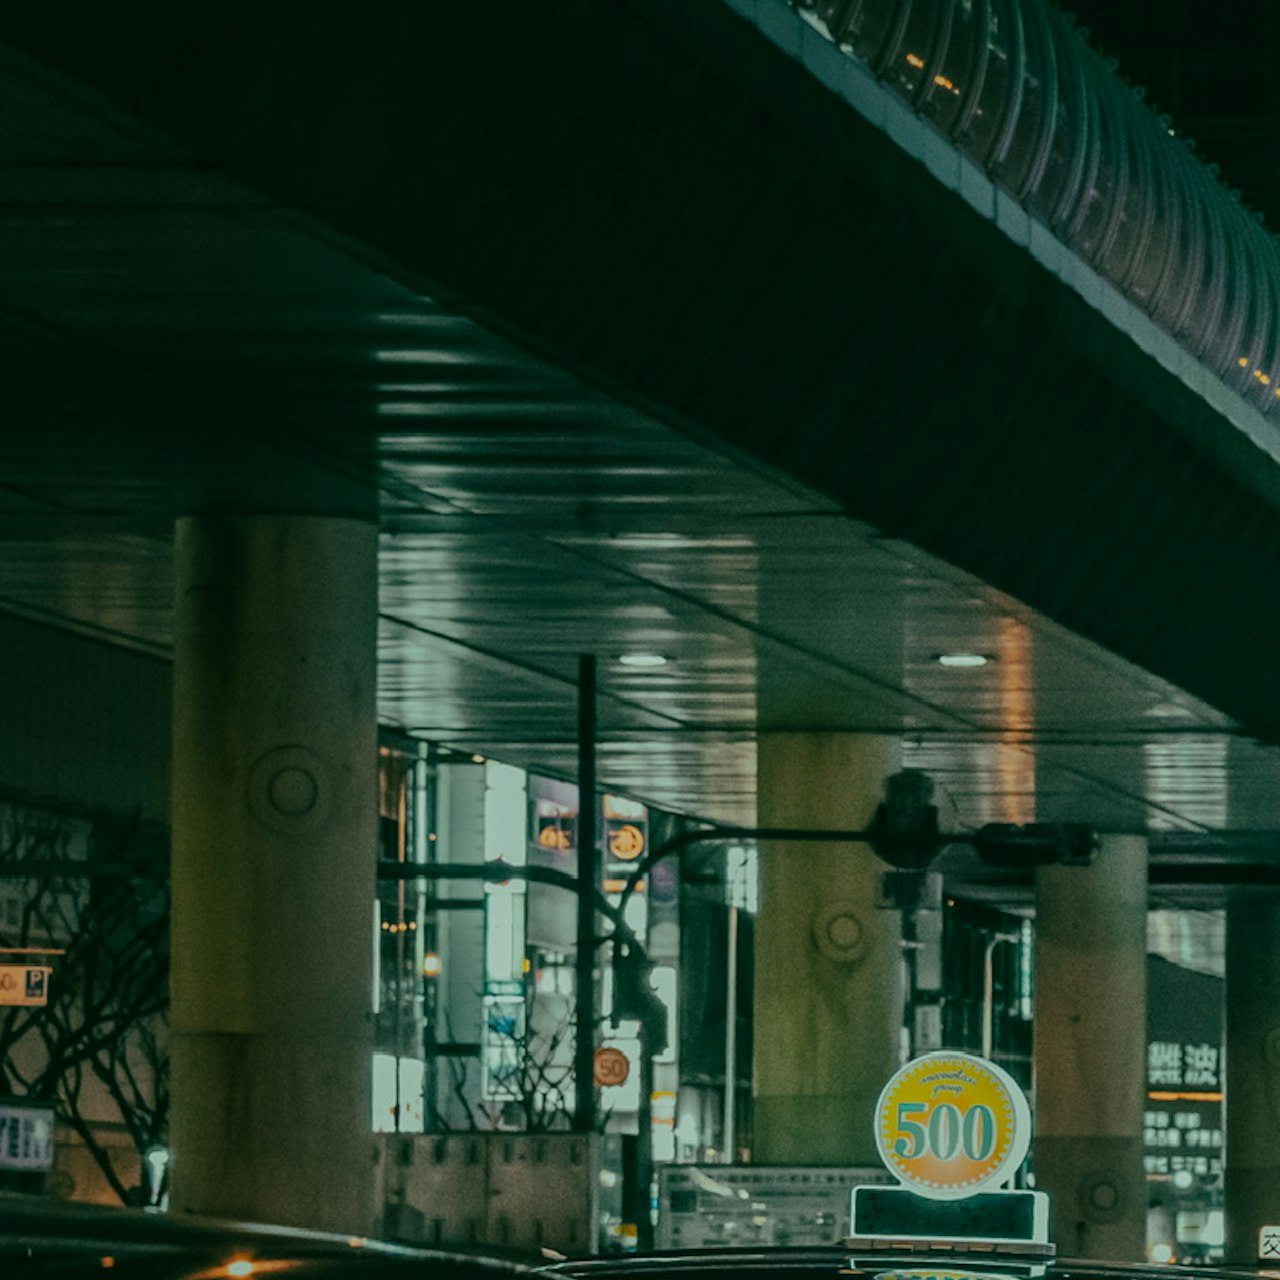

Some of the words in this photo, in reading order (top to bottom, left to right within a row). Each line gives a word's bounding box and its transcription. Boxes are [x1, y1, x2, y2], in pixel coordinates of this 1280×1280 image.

[600, 1060, 624, 1079] 50
[1147, 1040, 1218, 1085] 難波
[894, 1101, 995, 1161] 500
